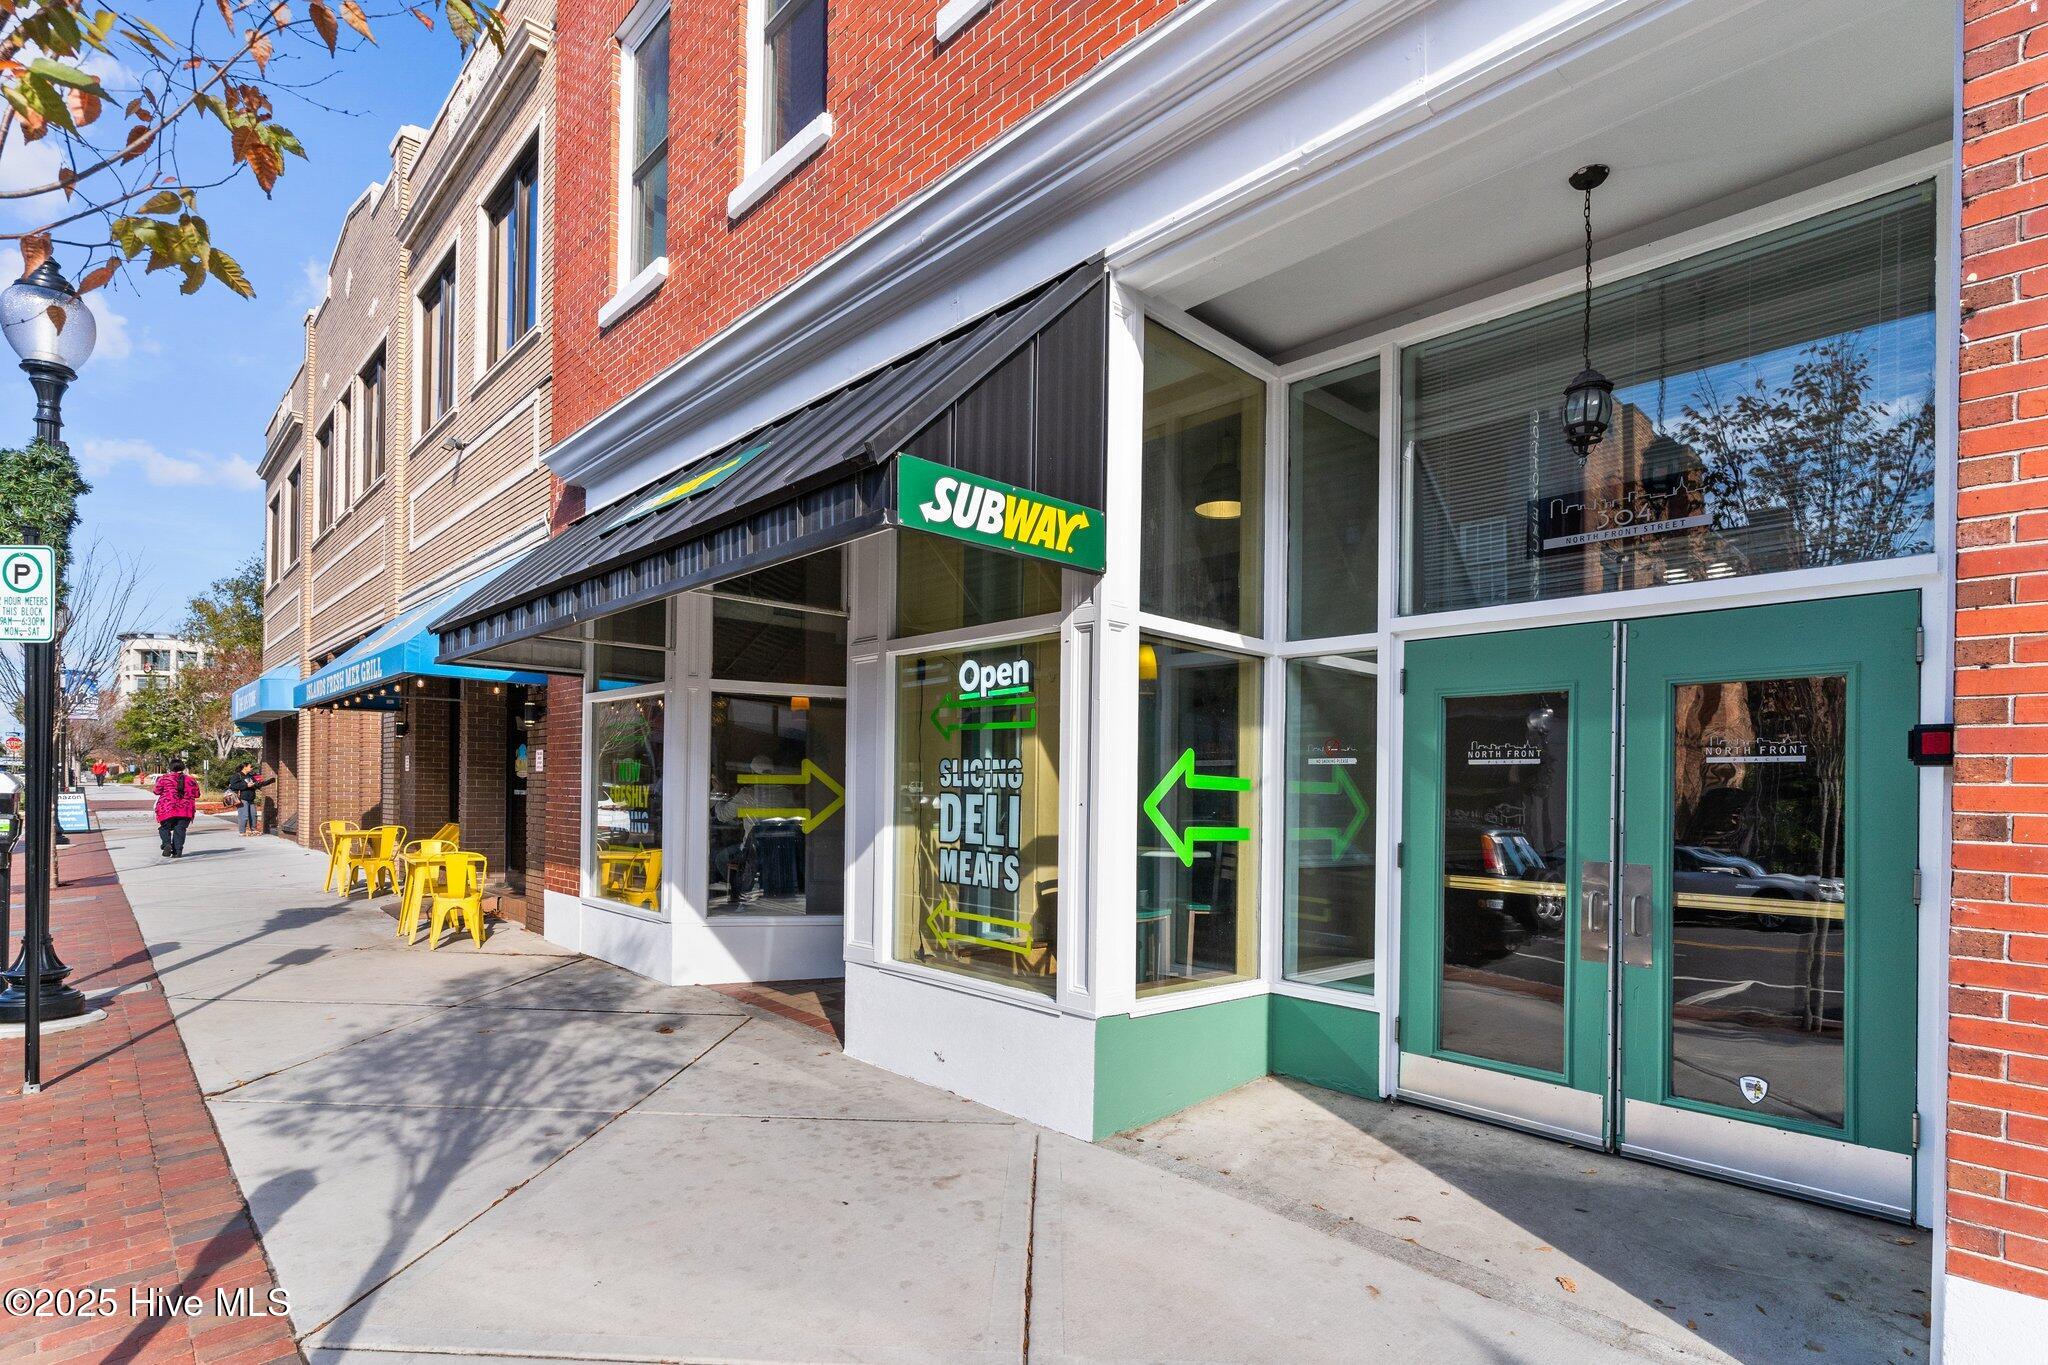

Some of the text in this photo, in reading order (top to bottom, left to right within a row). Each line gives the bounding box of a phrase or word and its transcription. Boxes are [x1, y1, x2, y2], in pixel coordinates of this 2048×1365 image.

[919, 477, 1089, 553] SUBWAY
[1598, 503, 1651, 530] 304
[1566, 519, 1687, 545] NORTH FRONT STREET
[14, 563, 31, 584] P
[3, 607, 43, 616] THIS BLOCK
[4, 597, 21, 605] HOUR
[25, 597, 48, 605] METERS
[326, 671, 345, 694] FRESH
[345, 664, 360, 687] MEX
[361, 657, 383, 682] GRILL
[959, 659, 1030, 698] Open
[1467, 749, 1541, 759] NORTH FRONT
[1705, 744, 1808, 756] NORTH FRONT
[939, 757, 1023, 789] SLICING
[939, 792, 1020, 849] DELI
[939, 848, 1020, 893] MEATS
